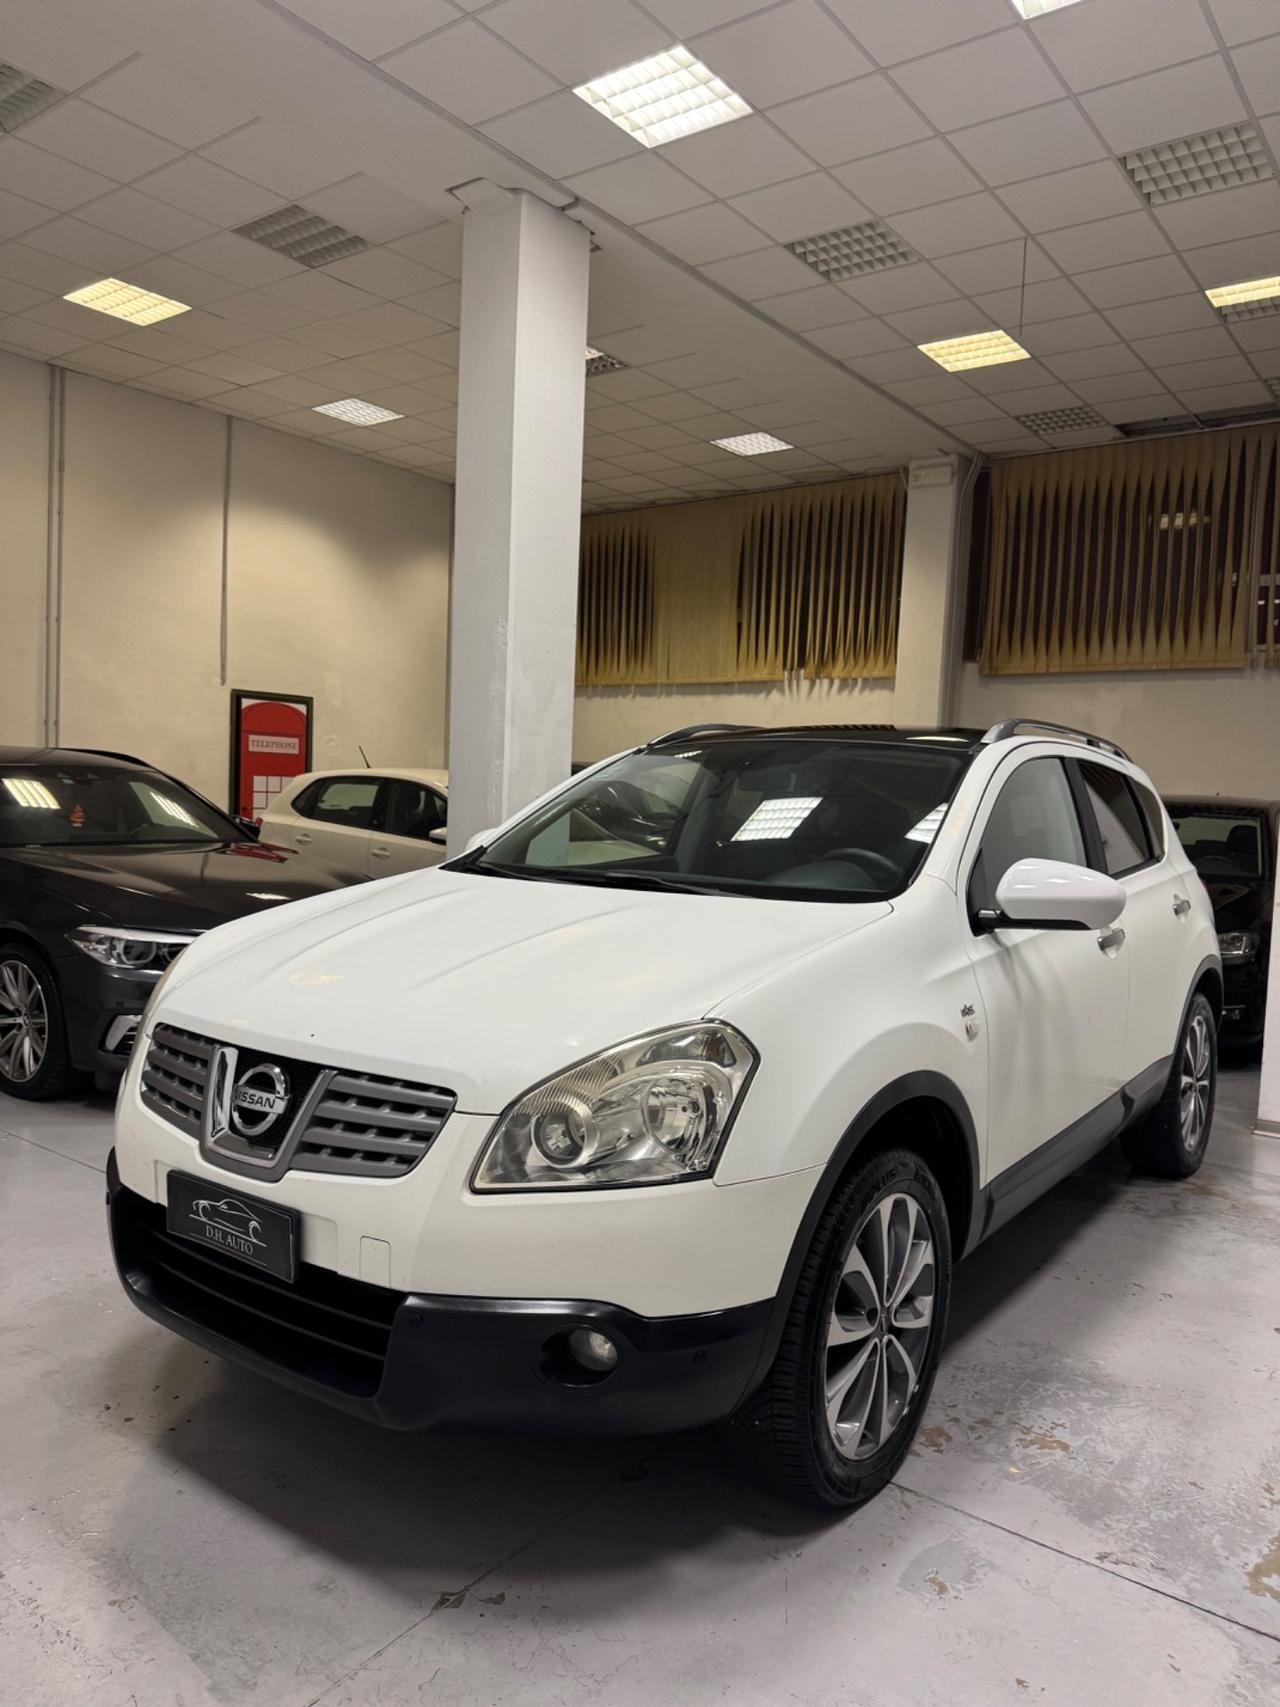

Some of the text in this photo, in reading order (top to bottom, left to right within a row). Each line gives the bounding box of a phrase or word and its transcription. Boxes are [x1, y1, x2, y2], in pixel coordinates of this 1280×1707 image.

[251, 739, 297, 750] TELEPHONE
[206, 1224, 253, 1256] D.H. AUTO
